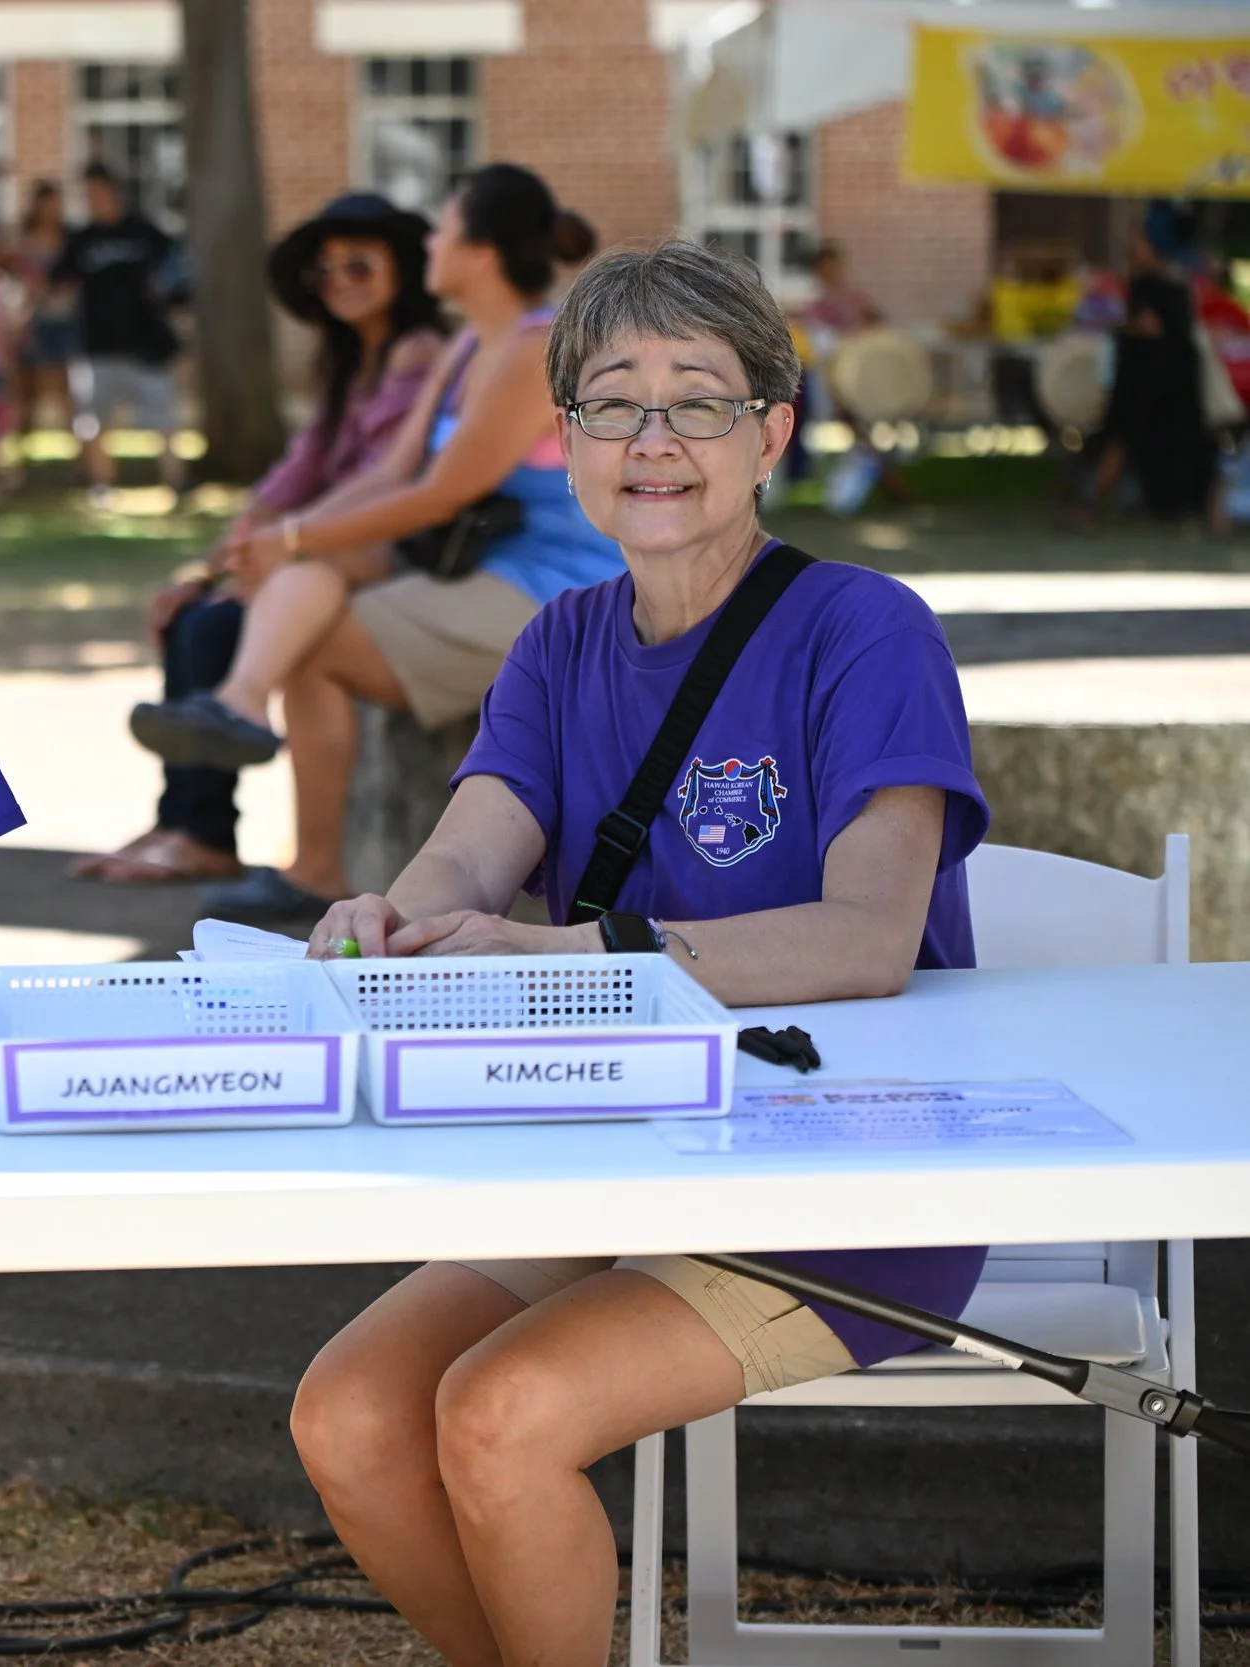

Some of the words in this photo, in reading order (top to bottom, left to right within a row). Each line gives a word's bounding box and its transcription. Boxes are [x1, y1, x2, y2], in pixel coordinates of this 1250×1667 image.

[715, 795, 747, 803] COMMERCE
[716, 847, 730, 855] 1940
[485, 1061, 624, 1084] KIMCHEE
[60, 1070, 283, 1099] JAJANGMYEON
